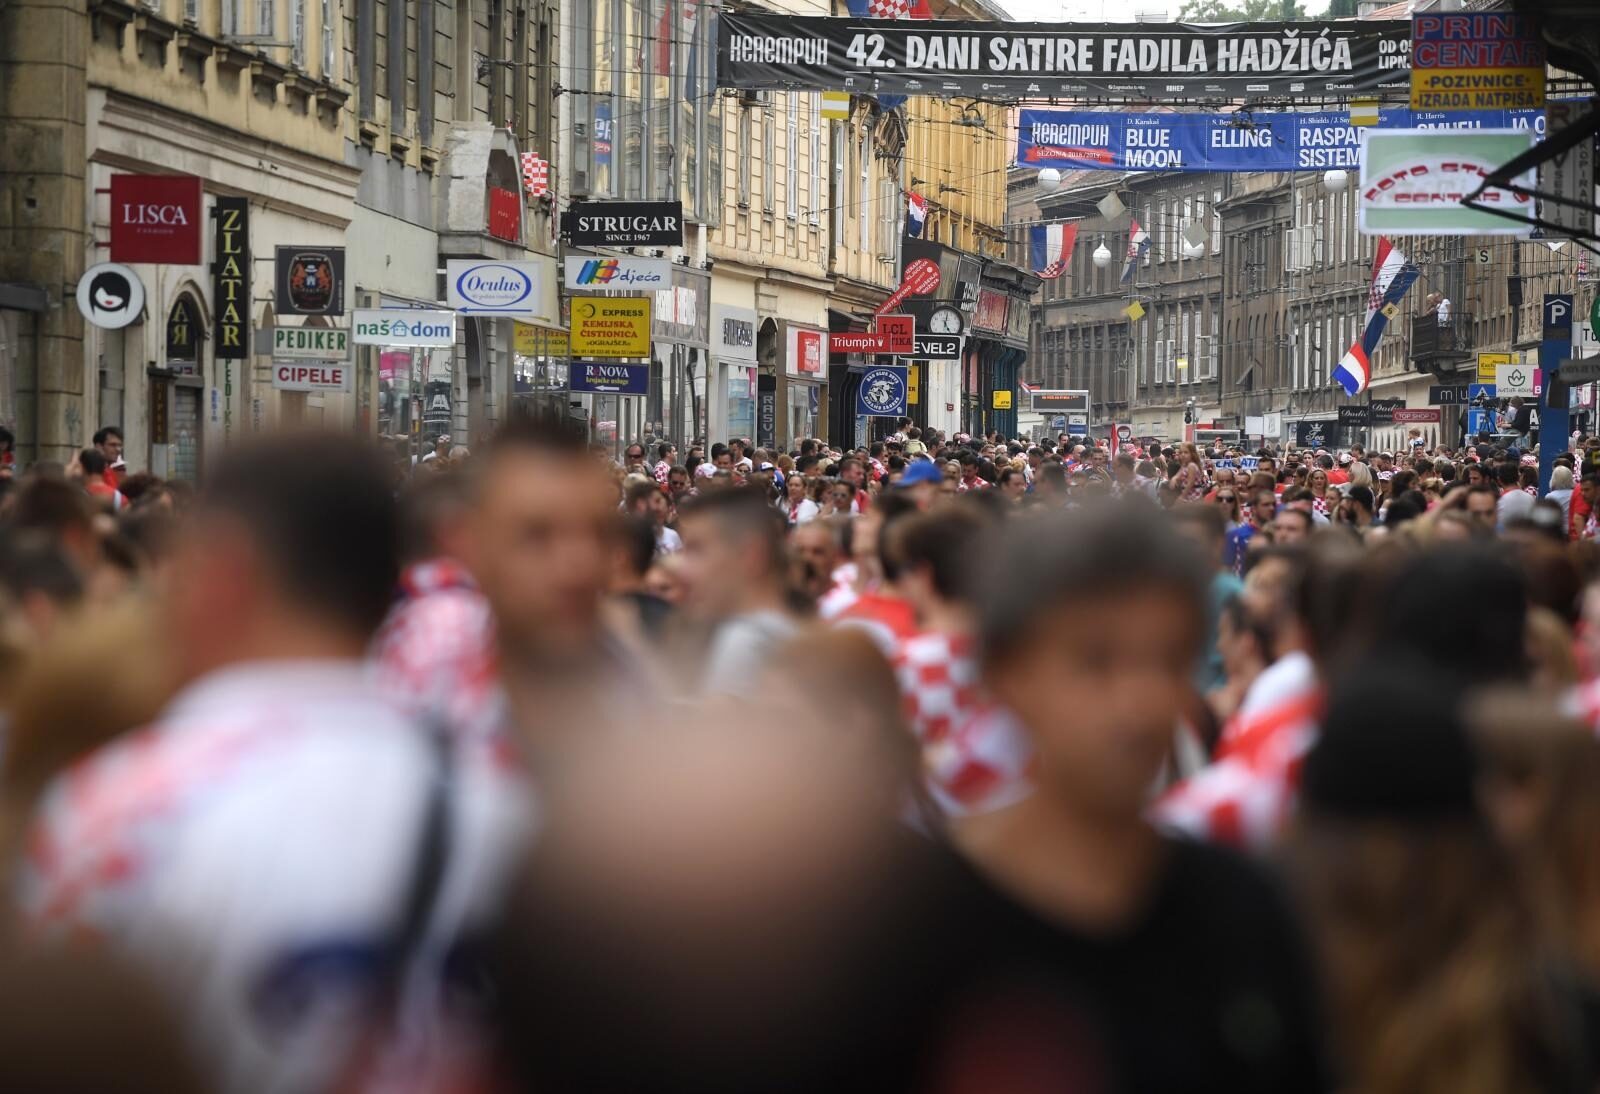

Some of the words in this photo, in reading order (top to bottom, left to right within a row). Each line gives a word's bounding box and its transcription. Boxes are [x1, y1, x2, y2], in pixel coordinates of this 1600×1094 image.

[846, 33, 896, 68] 42.
[905, 35, 980, 70] DANI
[989, 36, 1094, 72] SATIRE
[1102, 37, 1208, 72] FADILA
[1217, 26, 1352, 71] HADŽIĆA
[1379, 39, 1397, 54] OD
[1414, 41, 1543, 67] CENTAR
[1429, 74, 1526, 88] POZIVNICE
[1419, 93, 1470, 107] IZRADA
[1425, 112, 1446, 120] Harris
[1126, 129, 1170, 147] BLUE
[1211, 129, 1272, 147] ELLING
[1036, 150, 1067, 158] SEZONA
[1125, 149, 1182, 168] MOON
[1364, 165, 1429, 201] FOTO
[122, 203, 188, 225] LISCA
[578, 216, 677, 233] STRUGAR
[605, 233, 632, 241] SINCE
[633, 233, 651, 242] 1967
[221, 208, 243, 347] ZLATAR
[467, 275, 521, 292] Oculus
[602, 309, 644, 317] EXPRESS
[1551, 304, 1566, 325] P
[357, 319, 390, 336] naš
[410, 321, 450, 338] dom
[580, 328, 638, 338] ČISTIONICA
[582, 320, 634, 329] KEMIJSKA
[276, 330, 346, 350] PEDIKER
[832, 337, 875, 349] Triumph
[914, 342, 956, 354] EVEL2
[278, 367, 342, 384] CIPELE
[1215, 458, 1259, 468] CROATI
